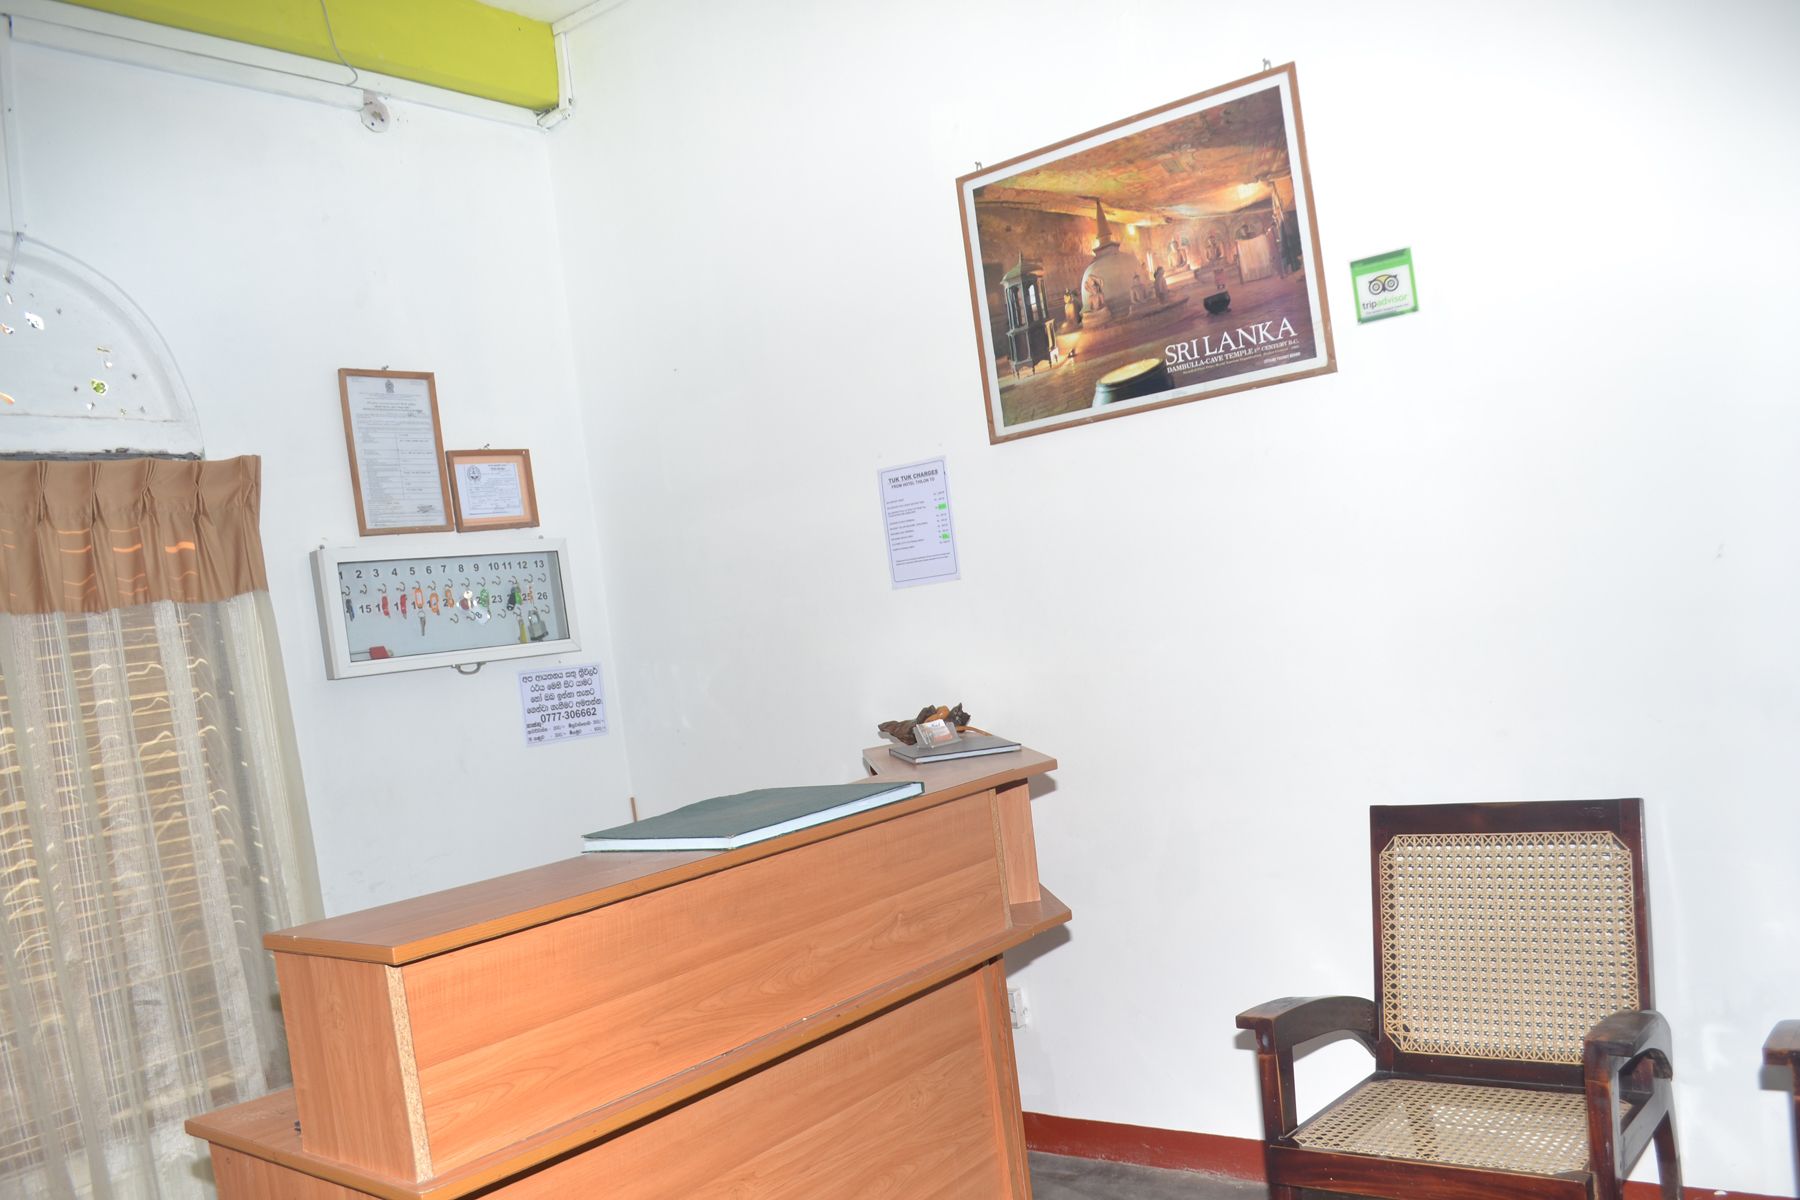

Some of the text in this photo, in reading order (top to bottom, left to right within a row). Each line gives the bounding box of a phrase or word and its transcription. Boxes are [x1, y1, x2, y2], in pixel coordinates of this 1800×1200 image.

[1165, 339, 1200, 366] SRI
[1203, 317, 1298, 356] LANKA
[1167, 355, 1222, 373] DAMBULLA-CAVE
[1224, 348, 1254, 361] TEMPLE
[1261, 341, 1288, 352] CENTURY
[913, 469, 938, 479] CHARGES
[339, 560, 545, 579] 1 2 3 4 5 6 7 8 9 10 11 12 13
[359, 604, 372, 613] 15
[491, 595, 502, 603] 23
[537, 592, 548, 600] 26
[540, 707, 597, 723] 0777-306662
